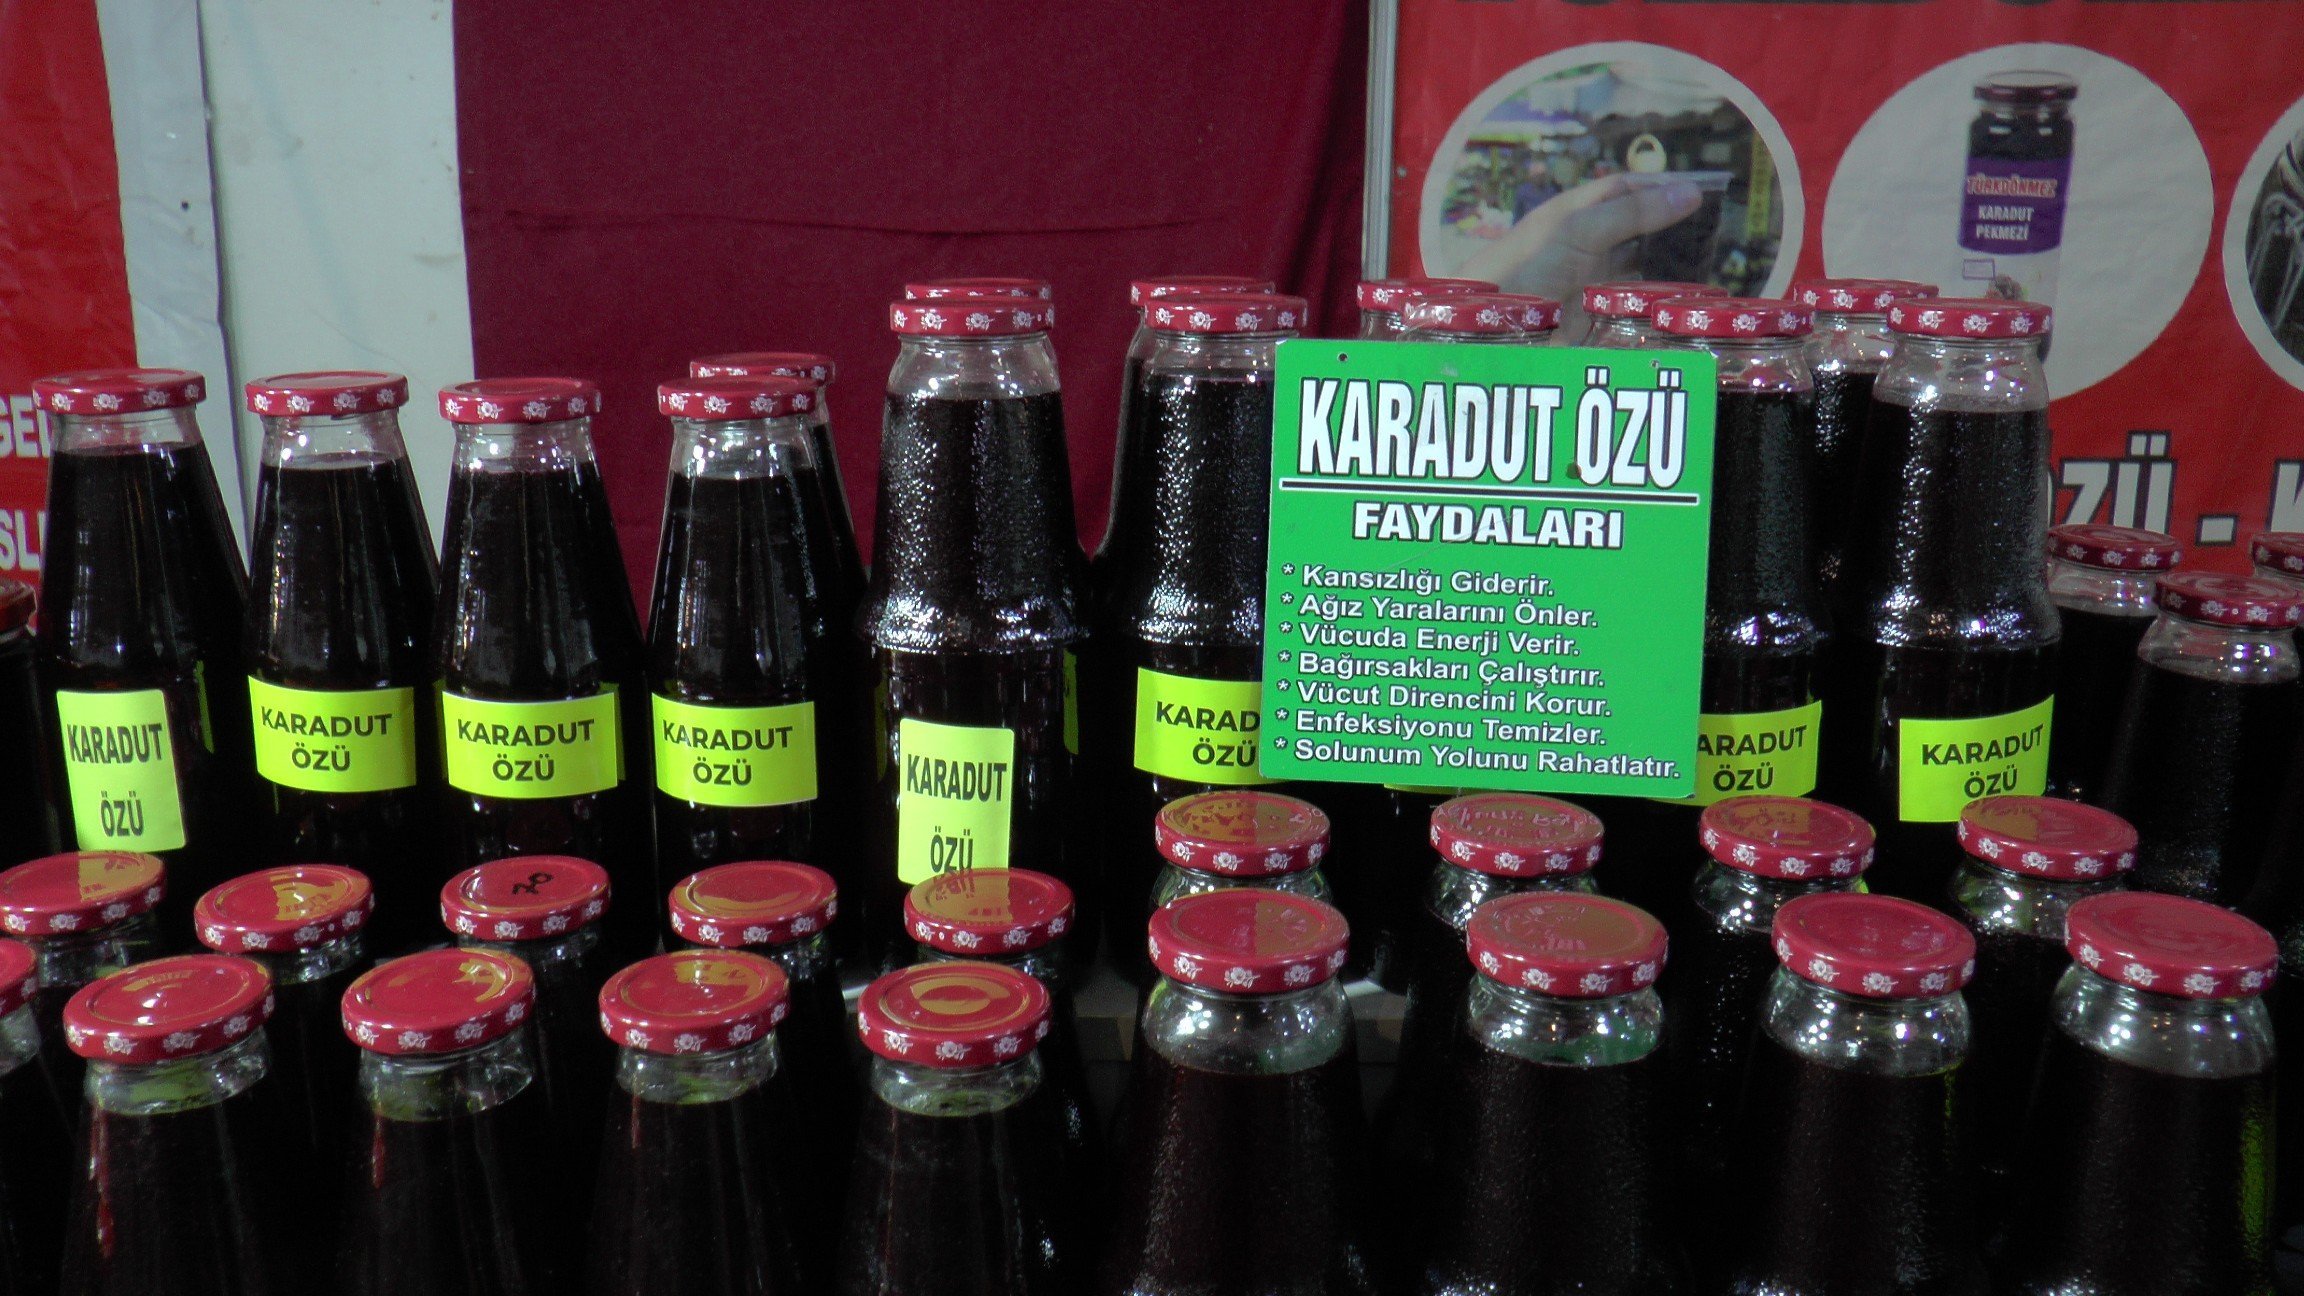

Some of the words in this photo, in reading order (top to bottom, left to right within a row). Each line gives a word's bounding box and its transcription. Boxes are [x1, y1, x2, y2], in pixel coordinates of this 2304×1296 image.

[1979, 205, 2034, 222] KARADUT
[1298, 377, 1562, 483] KARADUT
[1574, 366, 1689, 489] ÖZÜ
[2048, 430, 2176, 536] ZÜ
[1353, 502, 1625, 549] FAYDALARI
[1302, 564, 1441, 594] Kansızlığı
[1451, 570, 1555, 597] Giderir.
[1299, 593, 1363, 621] Ağız
[1372, 596, 1505, 623] Yaralarını
[1515, 598, 1599, 628] Önler.
[1300, 622, 1407, 650] Vücuda
[1417, 628, 1499, 657] Enerji
[1508, 632, 1581, 656] Verir.
[1298, 652, 1470, 681] Bağırsakları
[1478, 660, 1606, 688] Çalıştırır.
[1156, 700, 1261, 733] KARAD
[1298, 680, 1381, 707] Vücut
[1389, 685, 1516, 713] Direncini
[1525, 691, 1612, 718] Korur.
[261, 705, 393, 739] KARADUT
[457, 718, 595, 747] KARADUT
[662, 719, 794, 751] KARADUT
[1296, 710, 1474, 741] Enfeksiyonu
[1482, 718, 1607, 746] Temizler.
[66, 722, 163, 765] KARADUT
[291, 743, 352, 772] ÖZÜ
[1192, 736, 1257, 768] ÖZÜ
[1697, 725, 1808, 756] ARADUT
[1922, 723, 2045, 767] KARADUT
[492, 753, 555, 782] ÖZÜ
[692, 756, 753, 786] ÖZÜ
[1294, 738, 1423, 766] Solunum
[1431, 745, 1528, 772] Yolunu
[1538, 751, 1681, 779] Rahatlatır.
[907, 754, 1008, 803] KARADUT
[1712, 761, 1774, 792] ÖZÜ
[1963, 764, 2019, 800] ÖZÜ
[100, 791, 145, 838] ÖZÜ
[930, 825, 974, 874] ÖZÜ
